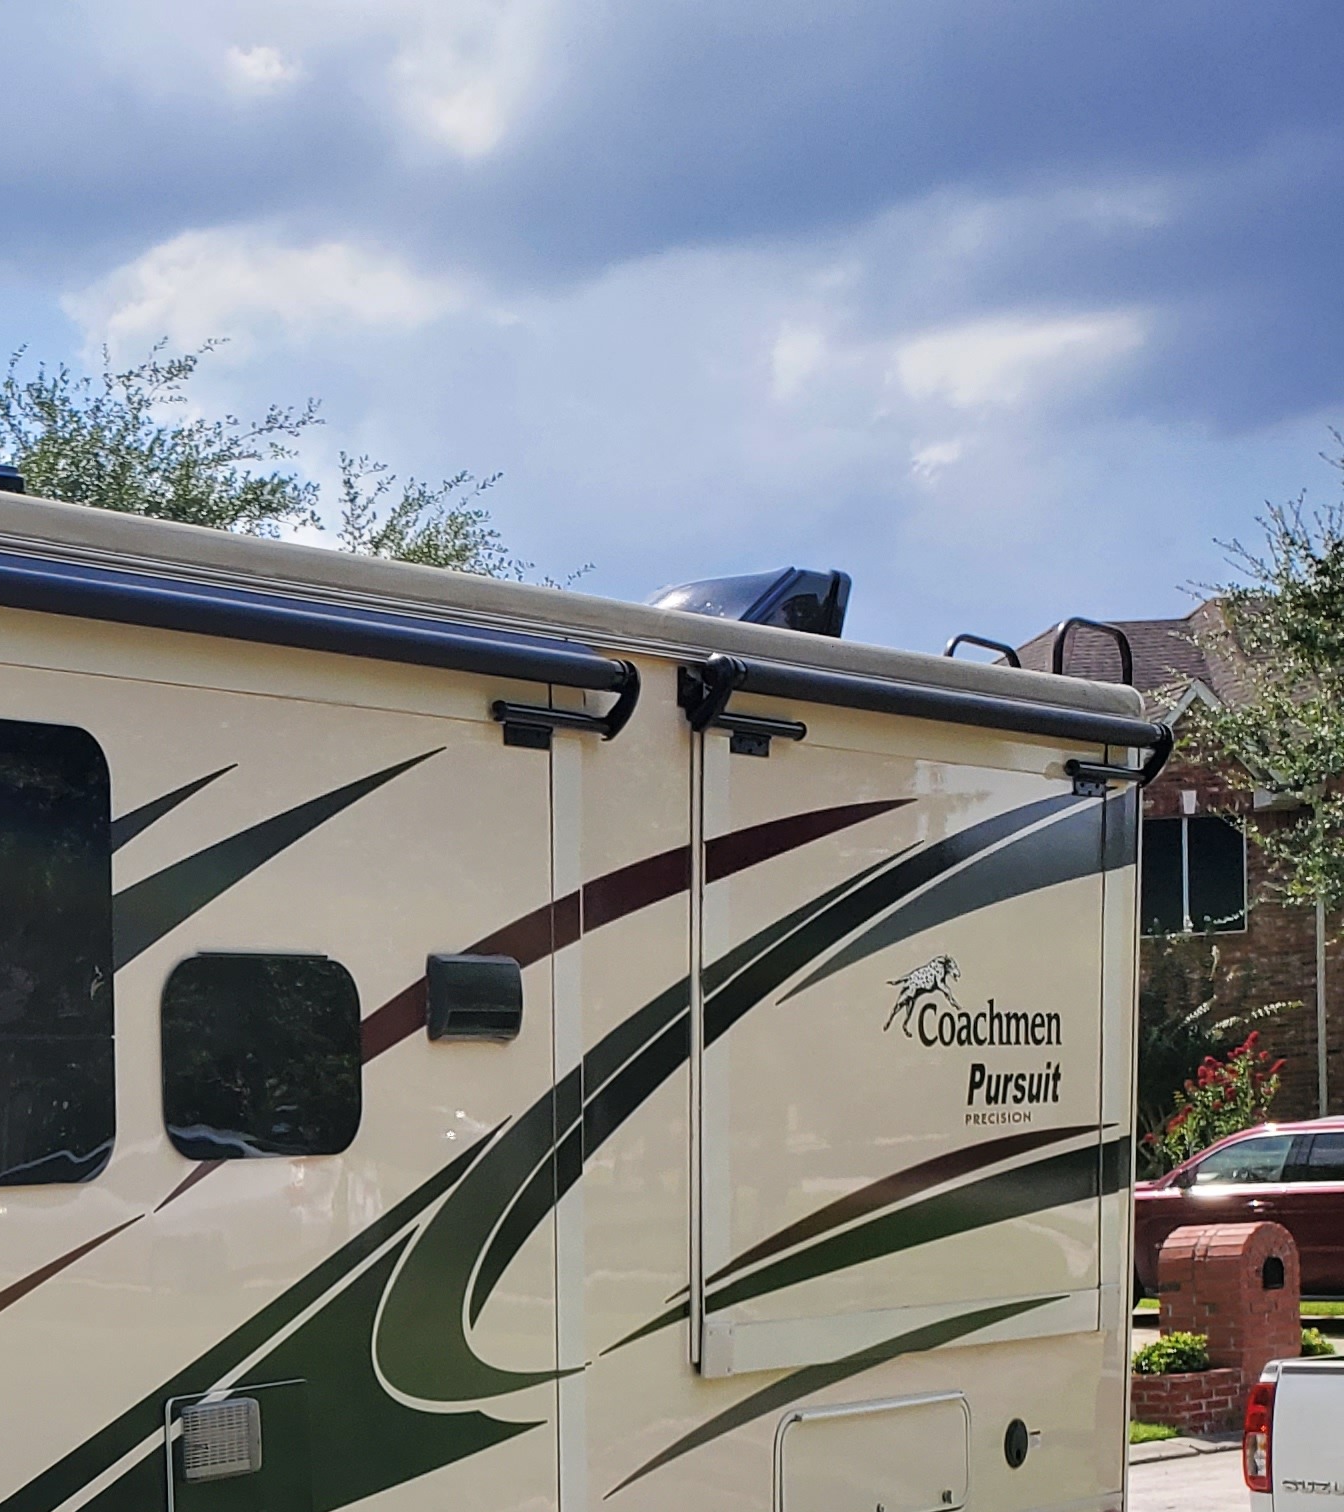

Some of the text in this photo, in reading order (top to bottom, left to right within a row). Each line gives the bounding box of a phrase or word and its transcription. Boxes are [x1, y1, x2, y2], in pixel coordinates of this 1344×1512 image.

[918, 998, 1062, 1047] Coachmen
[967, 1061, 1061, 1106] Pursuit
[965, 1111, 1032, 1126] PRECISION
